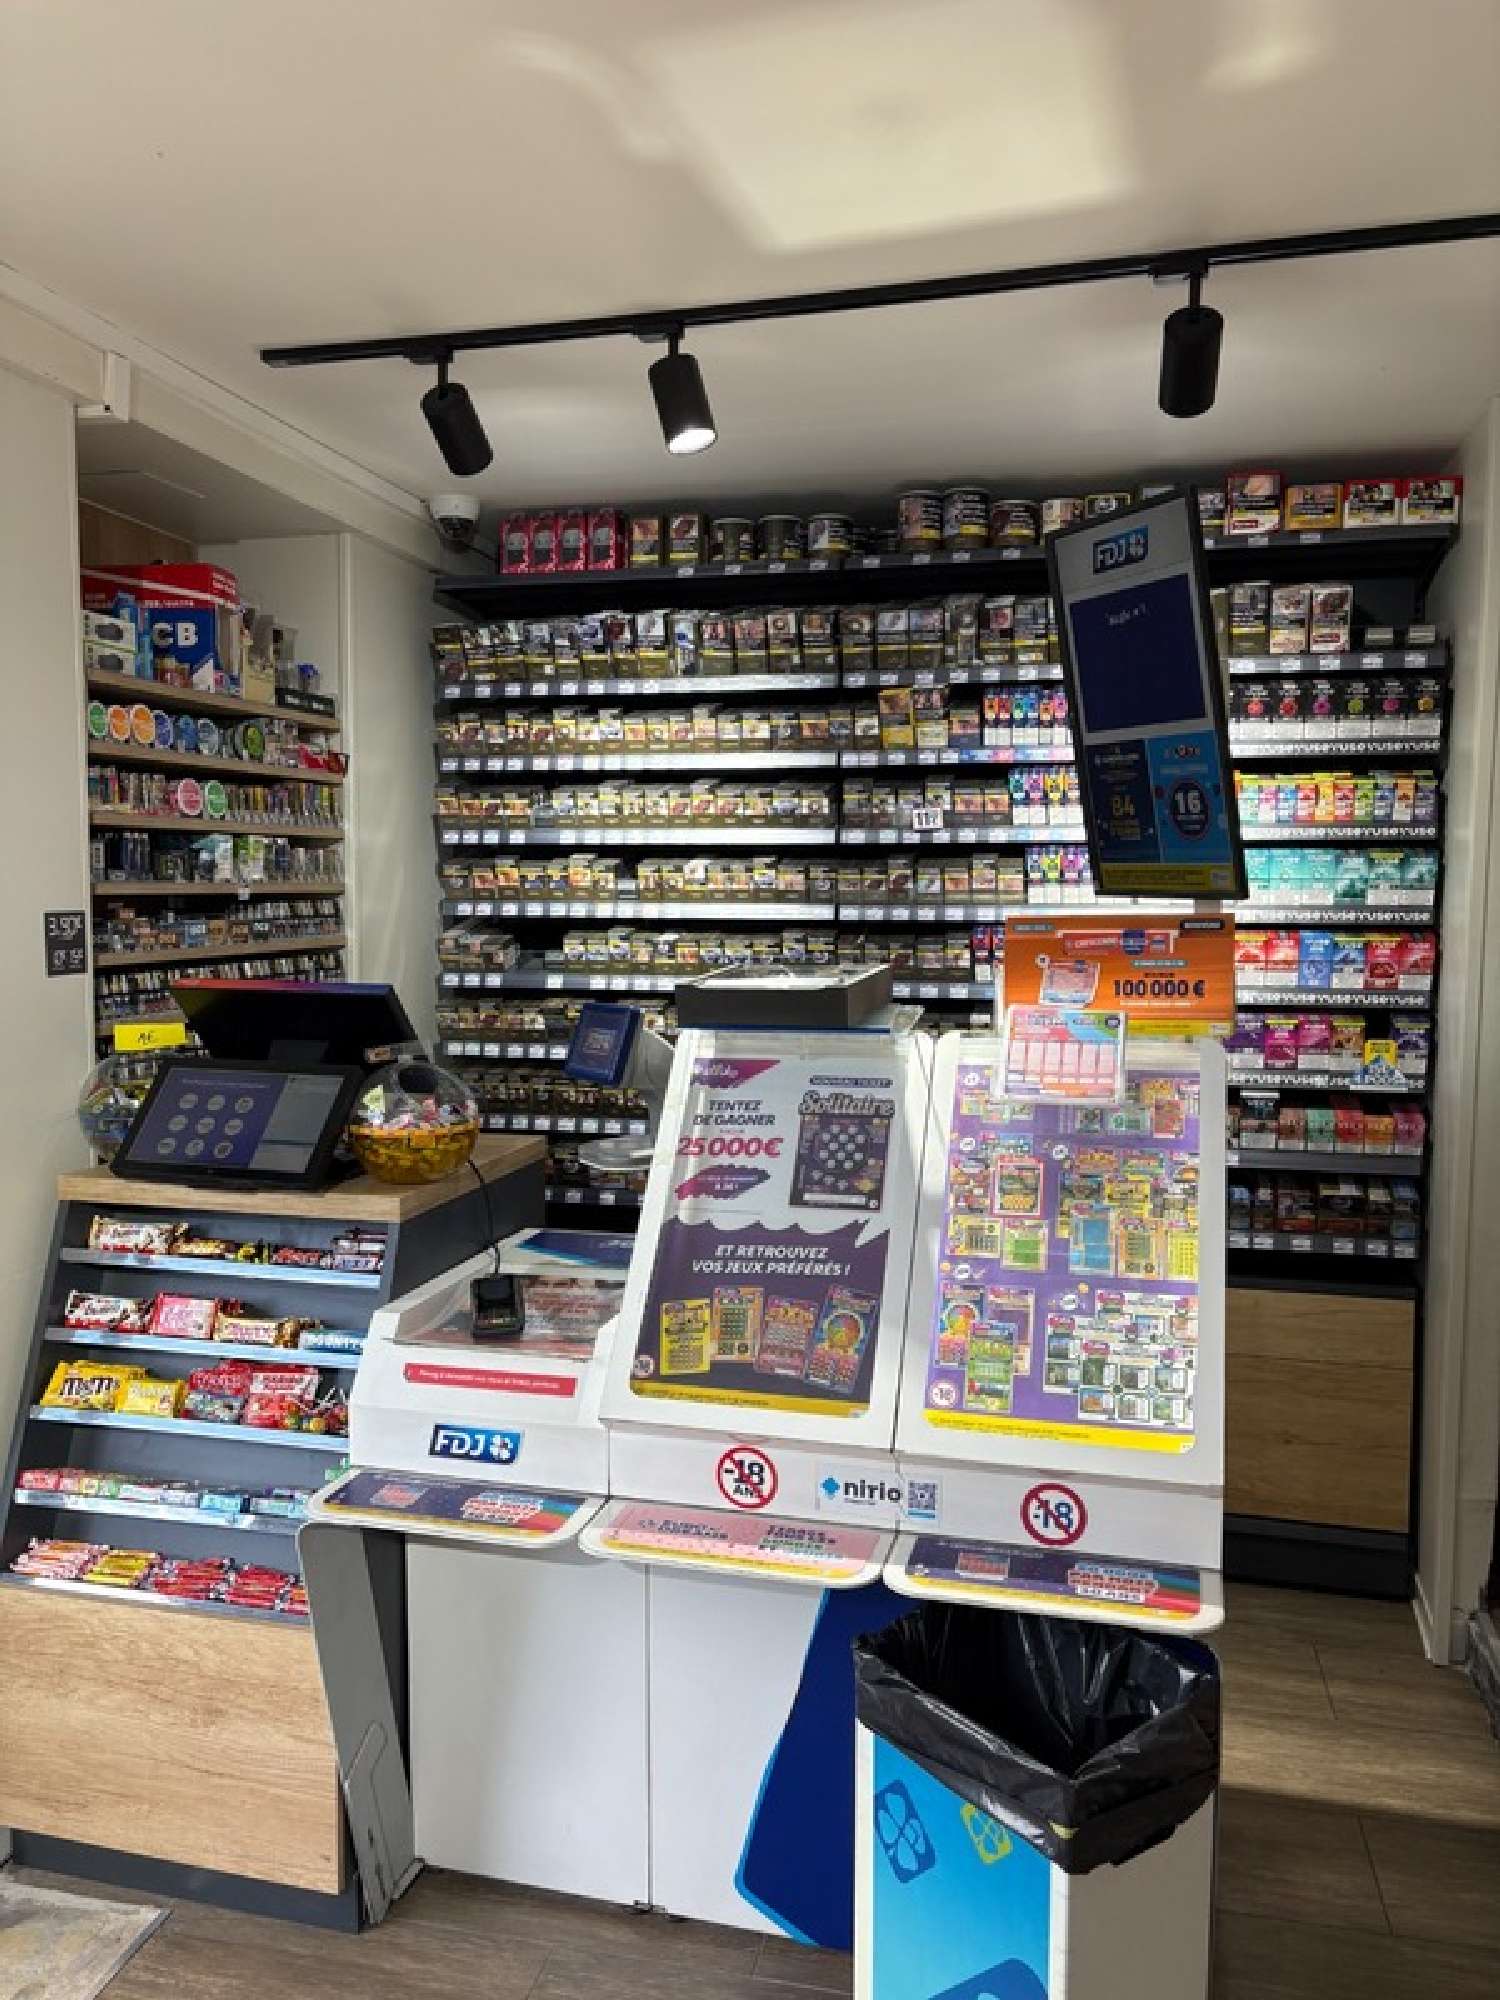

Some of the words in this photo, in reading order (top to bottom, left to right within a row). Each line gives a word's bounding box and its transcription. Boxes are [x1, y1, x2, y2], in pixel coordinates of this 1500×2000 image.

[1096, 539, 1126, 569] FDJ
[152, 621, 198, 647] CB
[1174, 790, 1201, 815] 16
[1114, 980, 1146, 998] 100
[1151, 980, 1189, 998] 000
[1193, 980, 1206, 997] €
[708, 1100, 762, 1112] TENTEZ
[800, 1090, 894, 1117] Solitaire
[693, 1114, 714, 1126] DE
[715, 1114, 776, 1126] GAGNER
[714, 1244, 735, 1257] ET
[737, 1245, 829, 1259] RETROUVEZ
[692, 1259, 723, 1273] VOS
[724, 1260, 764, 1275] JEUX
[434, 1428, 487, 1458] FDJ
[842, 1479, 901, 1503] nirio
